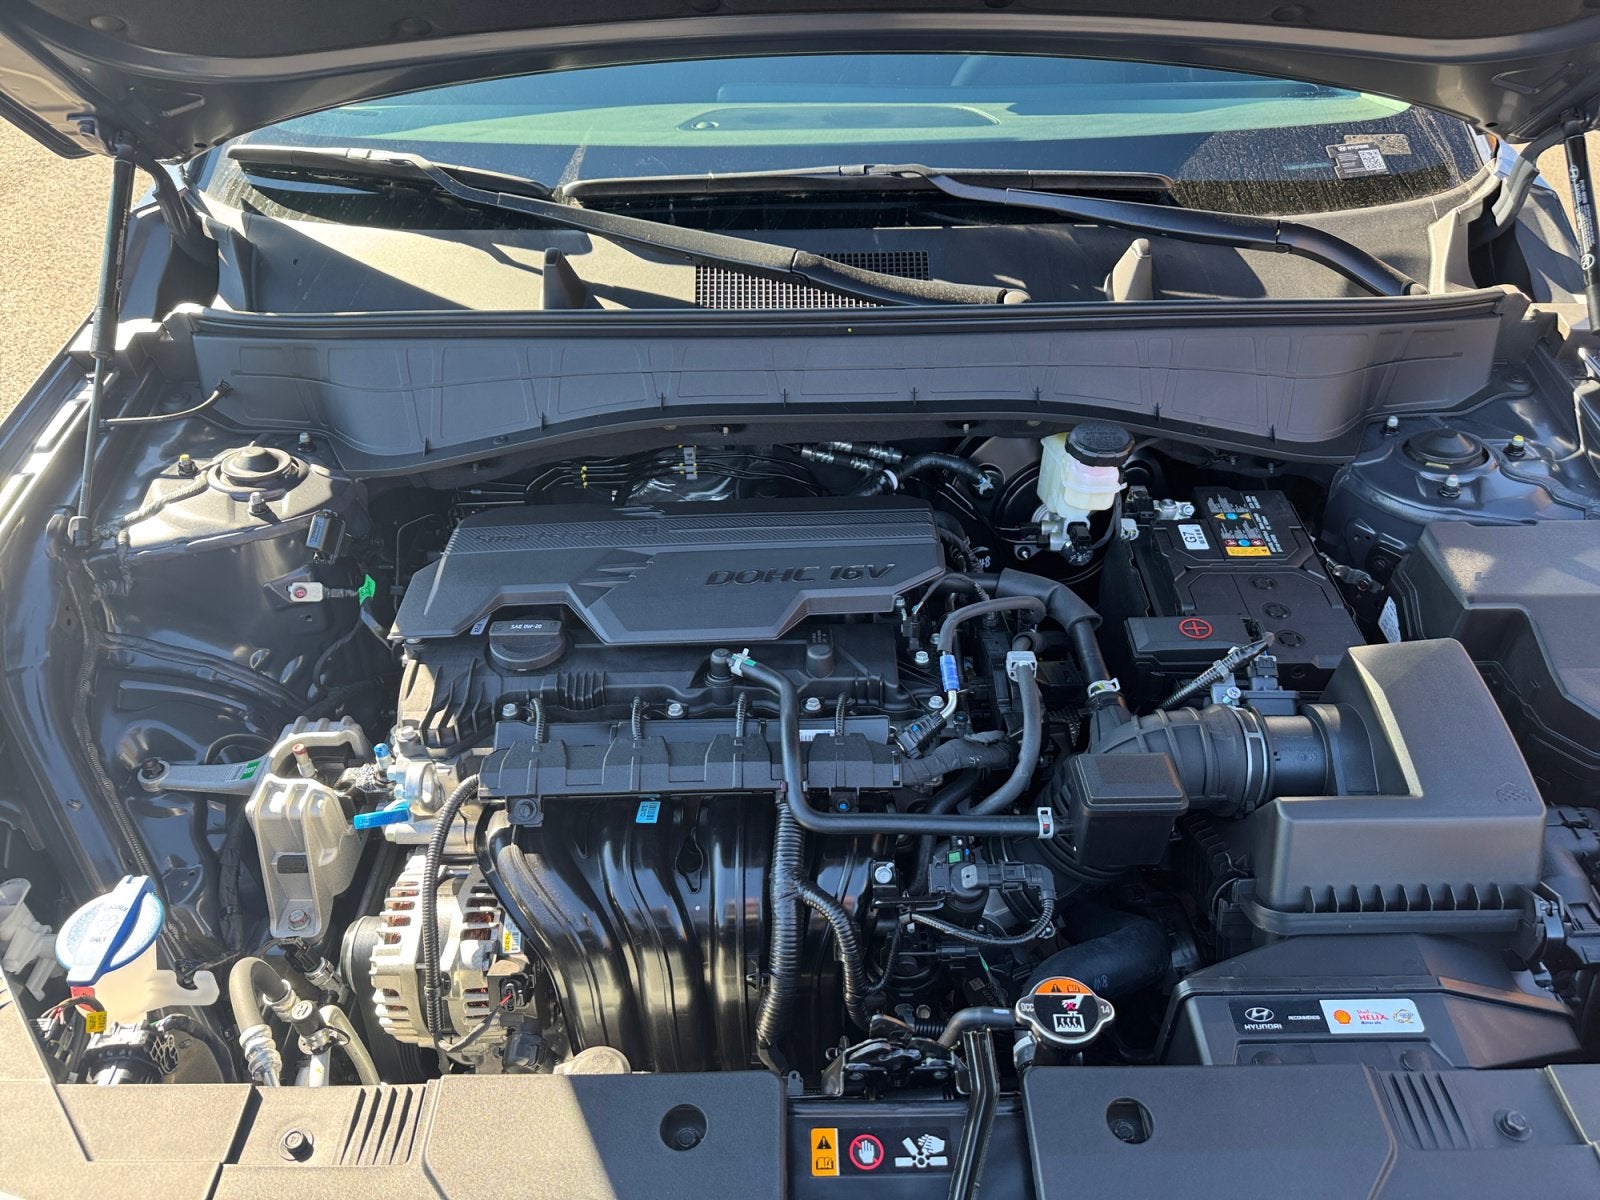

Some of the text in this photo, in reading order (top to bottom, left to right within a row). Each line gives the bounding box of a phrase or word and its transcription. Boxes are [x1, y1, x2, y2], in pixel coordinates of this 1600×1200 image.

[1183, 531, 1197, 543] G7
[704, 563, 895, 586] DOHC 16V
